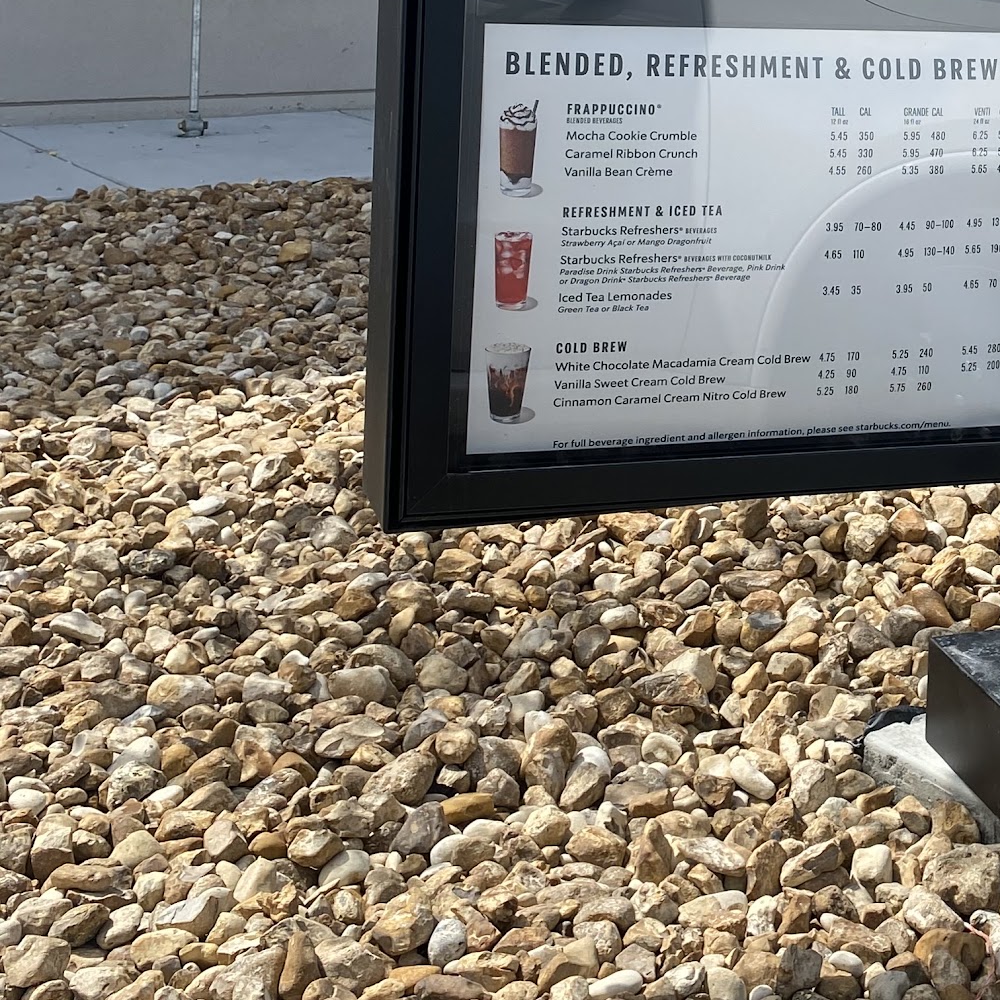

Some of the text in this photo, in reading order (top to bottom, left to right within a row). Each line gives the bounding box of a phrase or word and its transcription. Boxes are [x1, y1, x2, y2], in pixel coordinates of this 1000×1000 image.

[505, 51, 998, 81] BLENDED, REFRESHMENT & COLD BREW
[566, 130, 697, 141] Mocha Cookie Crumble
[565, 148, 698, 159] Caramel Ribbon Crunch
[564, 166, 673, 177] Vanilla Bean Crème
[562, 205, 722, 218] REFRESHMENT & ICED TEA
[558, 290, 672, 303] Iced Tea Lemonades
[556, 340, 627, 354] COLD BREW
[555, 354, 811, 372] White Chocolate Macadamia Cream Cold Brew
[553, 389, 787, 408] Cinnamon Caramel Cream Nitro Cold Brew
